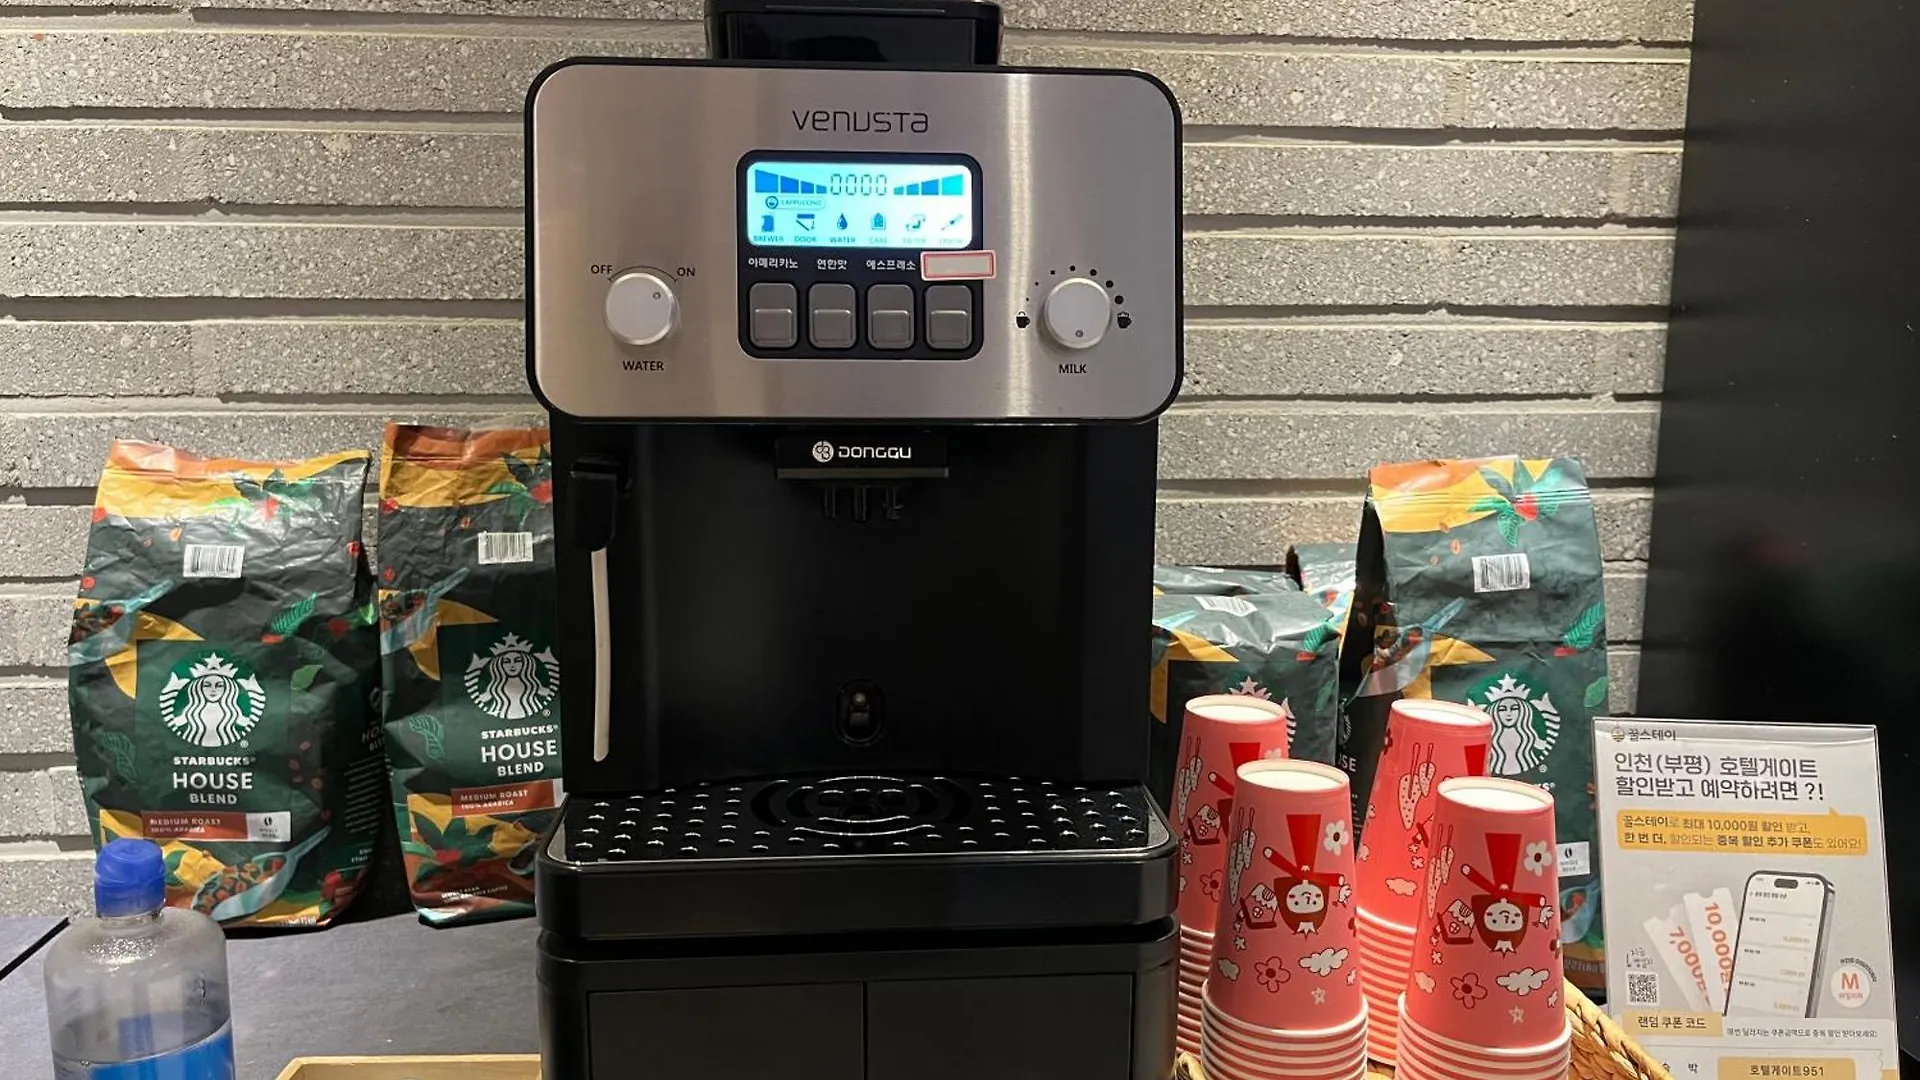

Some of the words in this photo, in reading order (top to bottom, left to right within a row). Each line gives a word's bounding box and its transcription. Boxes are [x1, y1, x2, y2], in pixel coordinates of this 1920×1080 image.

[753, 235, 784, 243] BREWER
[829, 236, 856, 244] WATER
[590, 264, 613, 274] OFF
[748, 257, 799, 269] 아메리카노
[817, 258, 848, 270] 연한맛
[866, 259, 916, 271] 에스프레소
[676, 267, 696, 277] ON
[622, 360, 665, 371] WATER
[1058, 363, 1087, 374] MILK
[1628, 728, 1676, 741] 꿀스테이
[481, 740, 558, 763] HOUSE
[497, 761, 544, 777] BLEND
[1614, 752, 1711, 776] 인천(부평)
[1719, 756, 1818, 778] 호텔게이트
[173, 771, 254, 790] HOUSE
[1615, 776, 1695, 797] 할인받고
[1701, 779, 1799, 801] 예약하려면
[189, 793, 237, 805] BLEND
[461, 793, 497, 802] MEDIUM
[499, 789, 528, 798] ROAST
[150, 818, 189, 826] MEDIUM
[191, 817, 221, 825] ROAST
[1708, 819, 1758, 832] 10,000원
[1624, 832, 1635, 844] 한
[1639, 832, 1649, 844] 번
[1840, 971, 1860, 990] M
[1638, 1016, 1659, 1028] 랜덤
[1661, 1017, 1683, 1029] 쿠폰
[1685, 1017, 1707, 1029] 코드
[1750, 1064, 1825, 1077] 호텔게이트951
